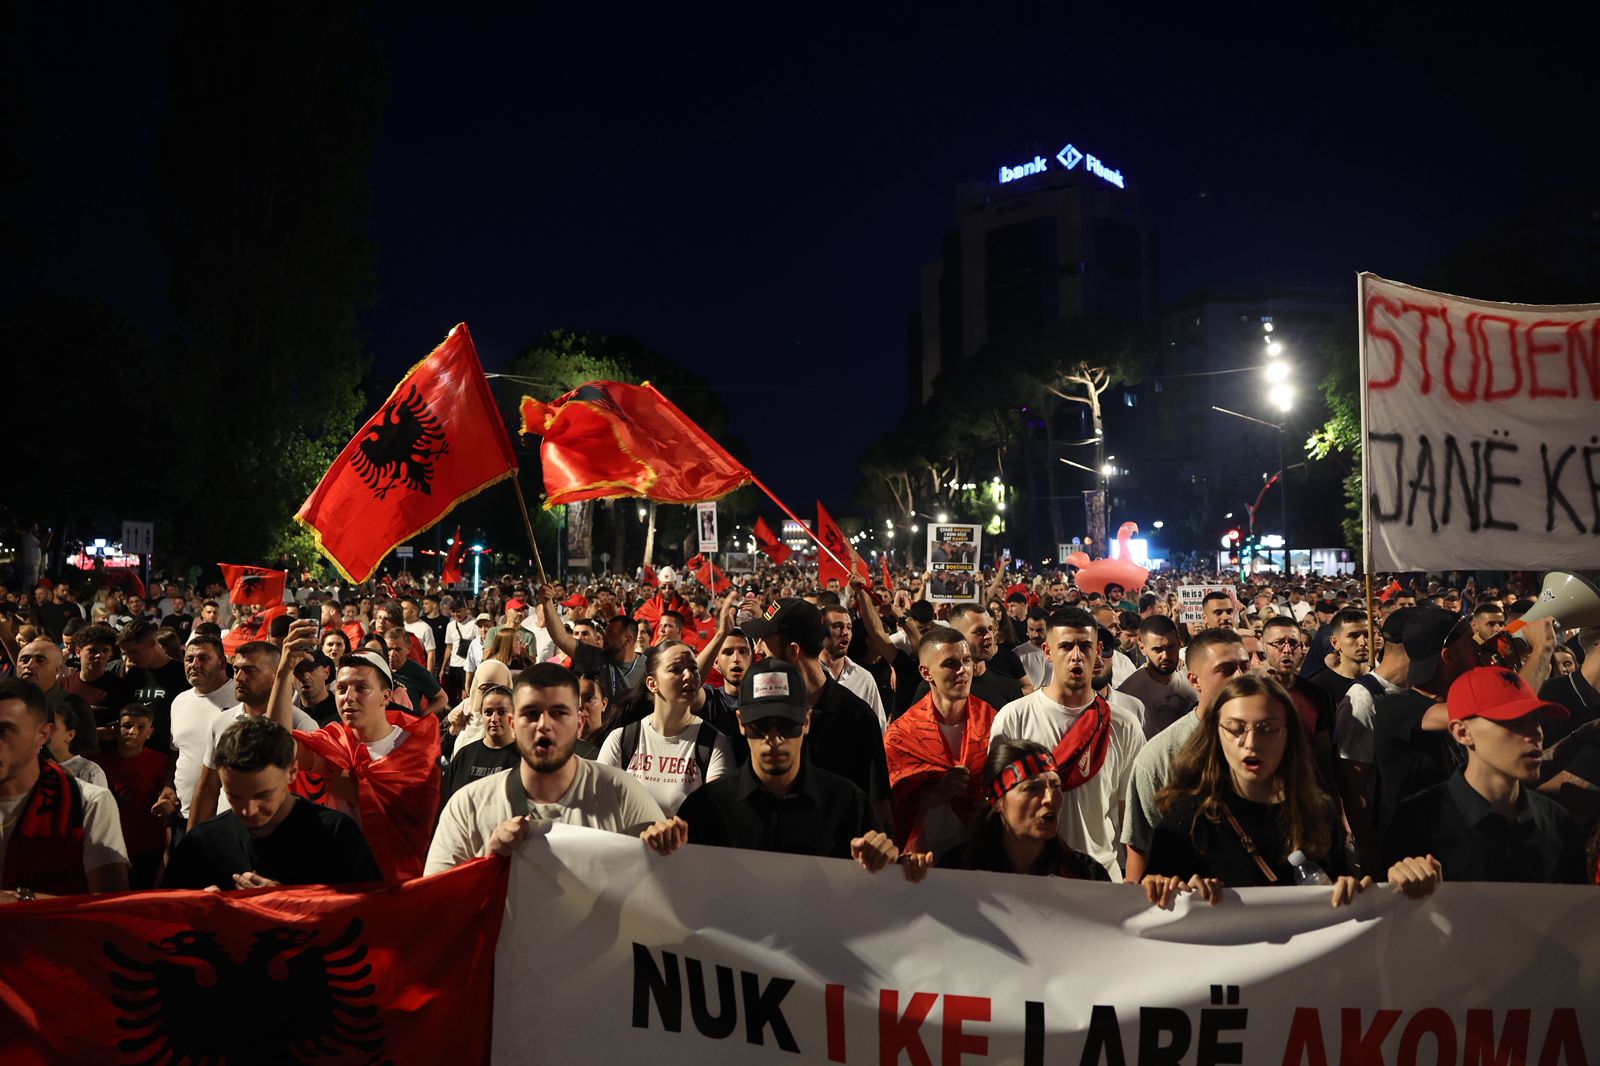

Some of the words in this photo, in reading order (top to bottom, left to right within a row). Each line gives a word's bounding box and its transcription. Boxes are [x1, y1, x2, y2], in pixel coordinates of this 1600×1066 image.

[1368, 429, 1522, 533] JANË
[1182, 590, 1191, 598] He
[1191, 590, 1197, 598] is
[1195, 612, 1202, 620] is
[134, 689, 166, 699] AIR
[632, 942, 801, 1054] NUK
[825, 984, 846, 1064] I
[1282, 1007, 1588, 1066] AKOMA
